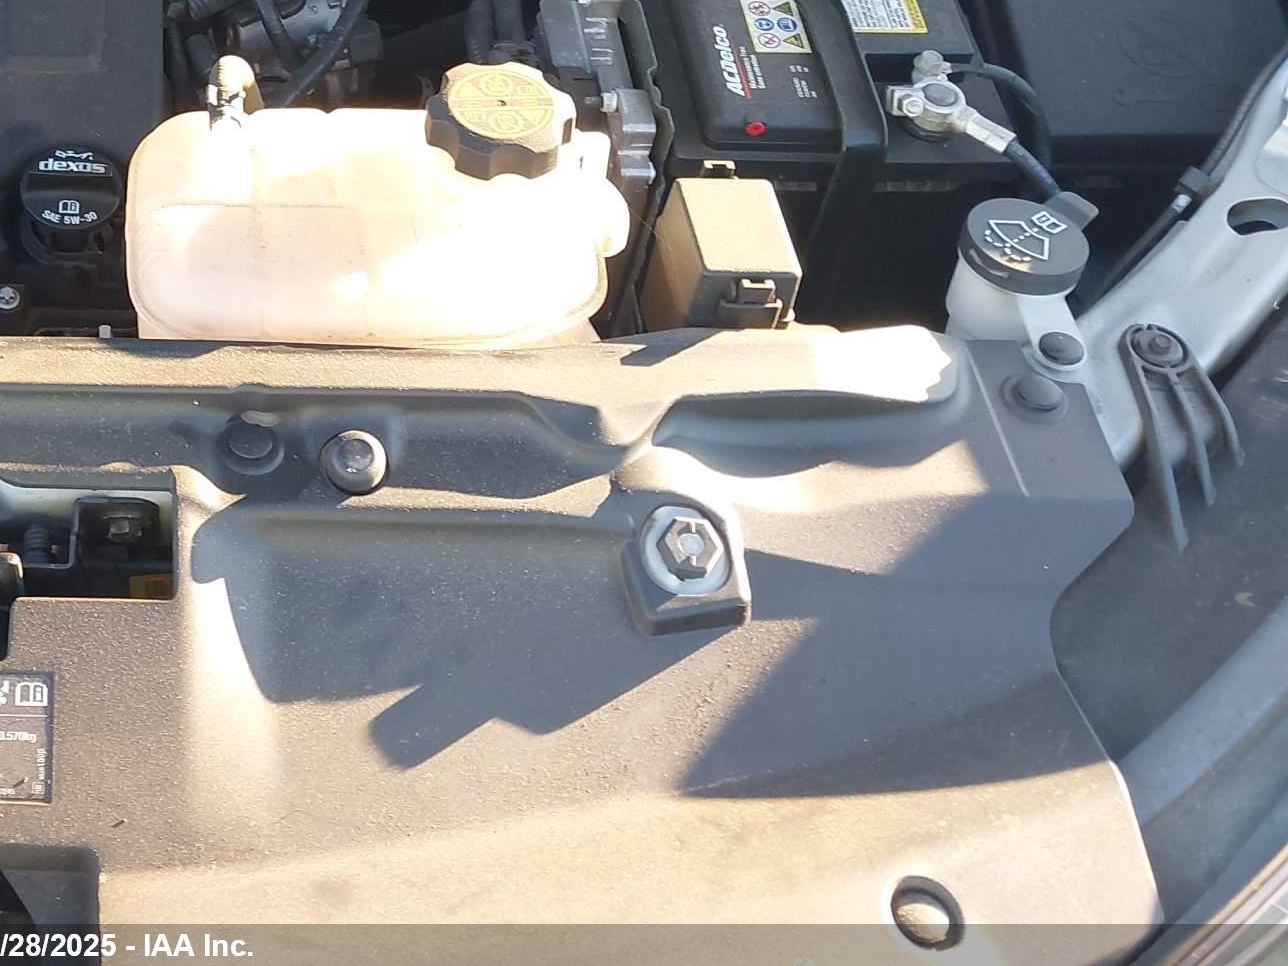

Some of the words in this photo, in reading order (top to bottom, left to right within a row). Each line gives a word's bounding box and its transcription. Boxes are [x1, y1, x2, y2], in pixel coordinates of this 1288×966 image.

[712, 25, 746, 97] ACDelco
[39, 158, 108, 173] dexos
[42, 210, 62, 223] SAE
[63, 211, 98, 225] 5W-30
